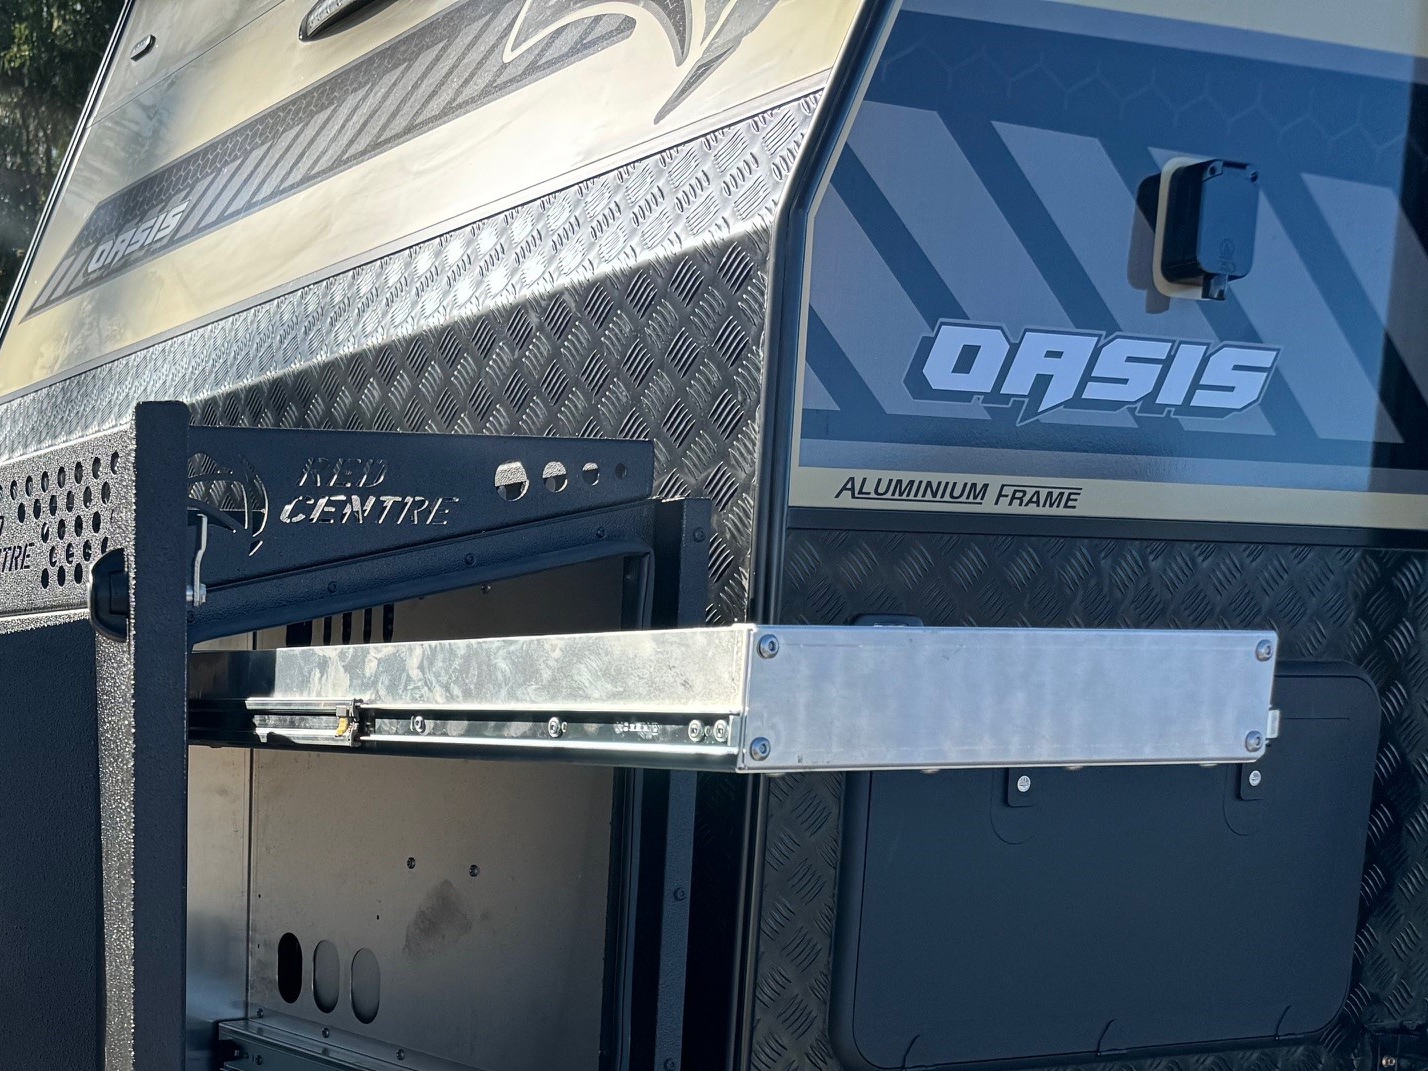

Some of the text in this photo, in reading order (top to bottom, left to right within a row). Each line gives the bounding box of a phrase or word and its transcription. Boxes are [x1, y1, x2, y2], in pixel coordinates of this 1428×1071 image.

[87, 201, 190, 274] OASIS
[917, 322, 1278, 416] OASIS
[298, 457, 388, 489] RED
[279, 495, 460, 526] CENTRE
[834, 476, 1083, 511] ALUMINIUM FRAME
